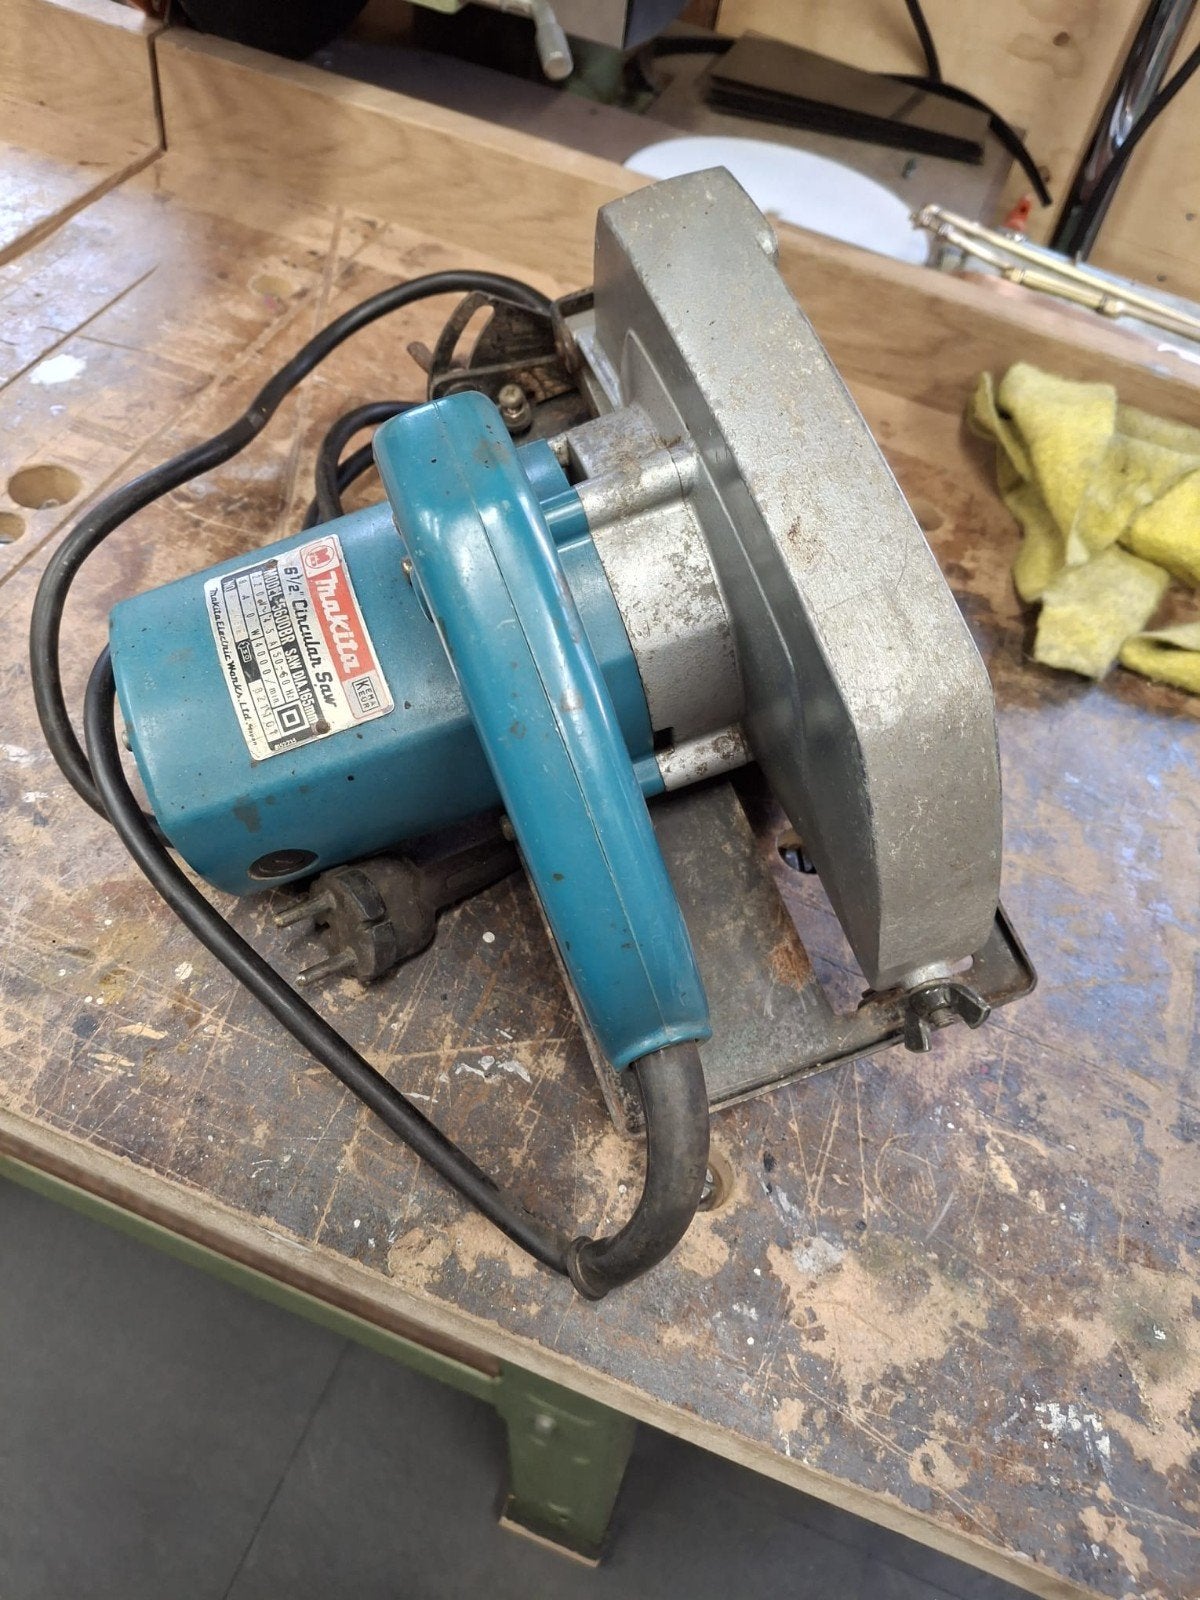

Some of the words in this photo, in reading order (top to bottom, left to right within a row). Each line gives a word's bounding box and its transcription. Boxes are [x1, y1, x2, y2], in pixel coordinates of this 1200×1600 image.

[263, 568, 284, 602] MODEL
[271, 602, 296, 646] 5600BR
[313, 570, 366, 675] Makita
[284, 647, 302, 671] SAW
[291, 597, 327, 669] Circular
[315, 669, 339, 710] Saw
